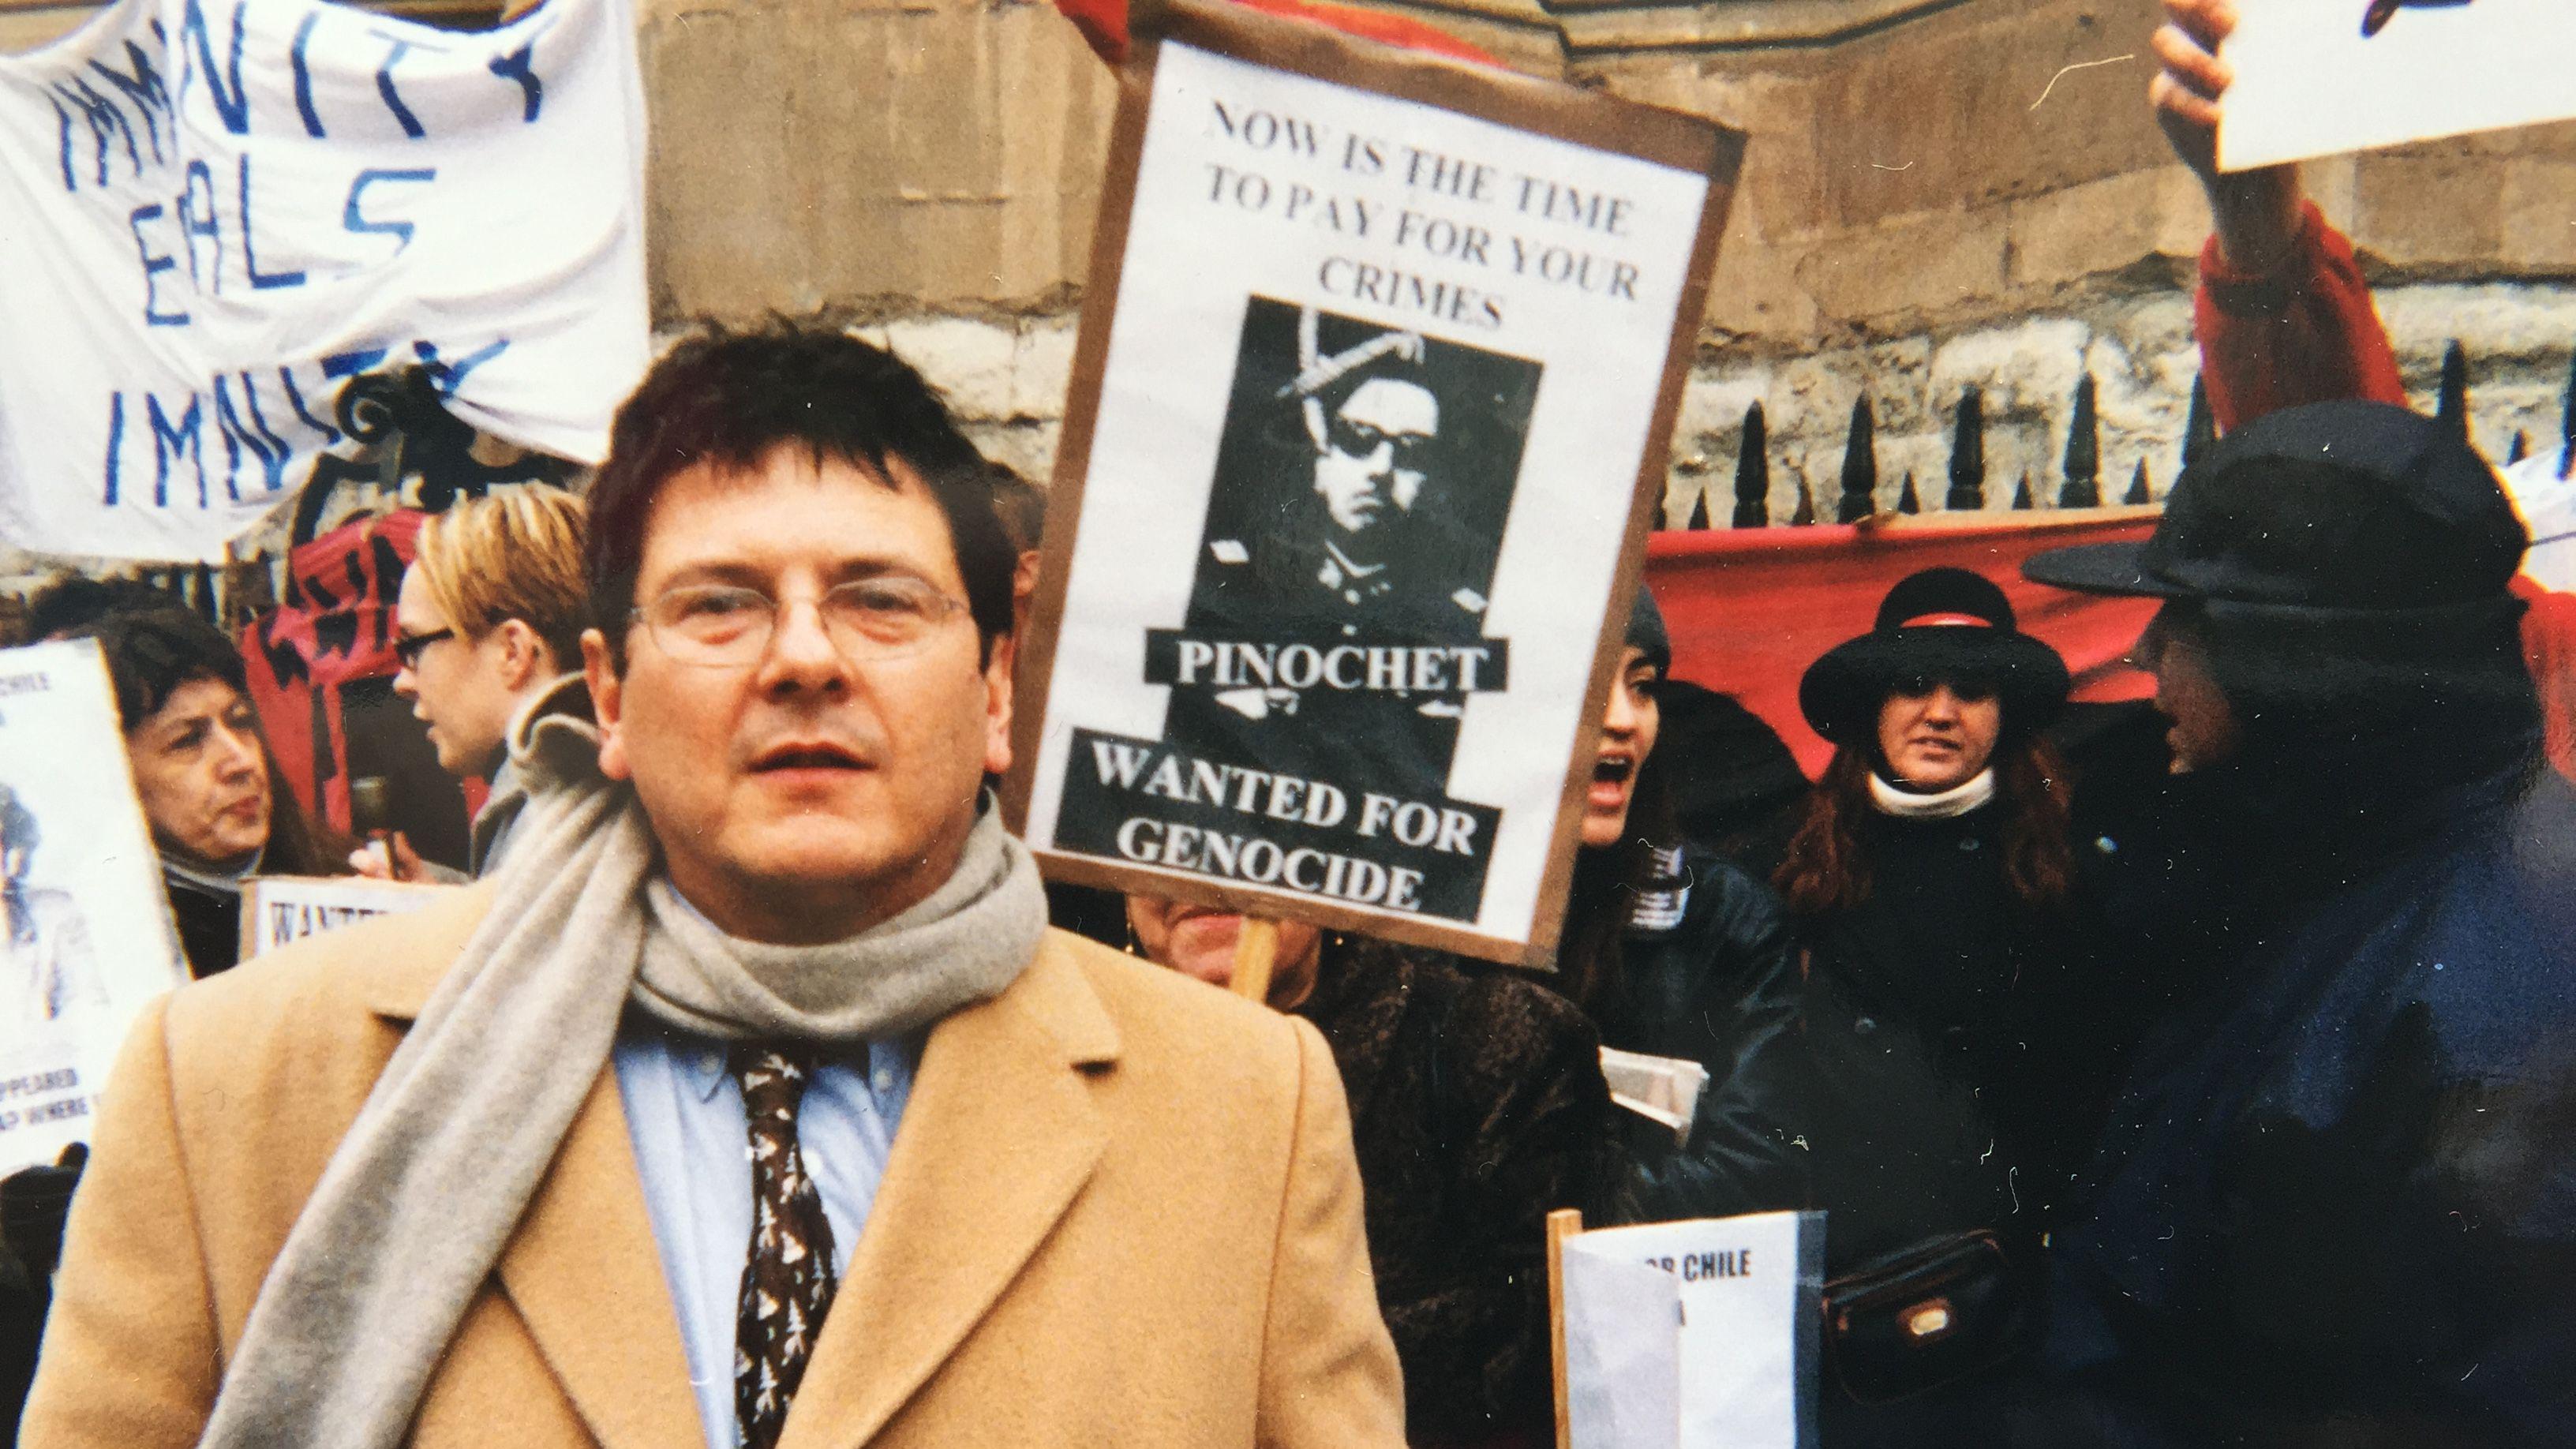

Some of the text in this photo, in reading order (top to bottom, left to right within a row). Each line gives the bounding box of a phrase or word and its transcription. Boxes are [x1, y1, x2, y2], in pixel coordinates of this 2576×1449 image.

[1207, 99, 1635, 236] NOW IS THE TIME
[1206, 163, 1641, 301] TO PAY FOR YOUR
[1318, 255, 1503, 329] CRIMES
[1176, 640, 1489, 691] PINOCHET
[1091, 739, 1478, 856] WANTED FOR
[1116, 816, 1425, 912] GENOCIDE
[1683, 1249, 1751, 1282] CHILE
